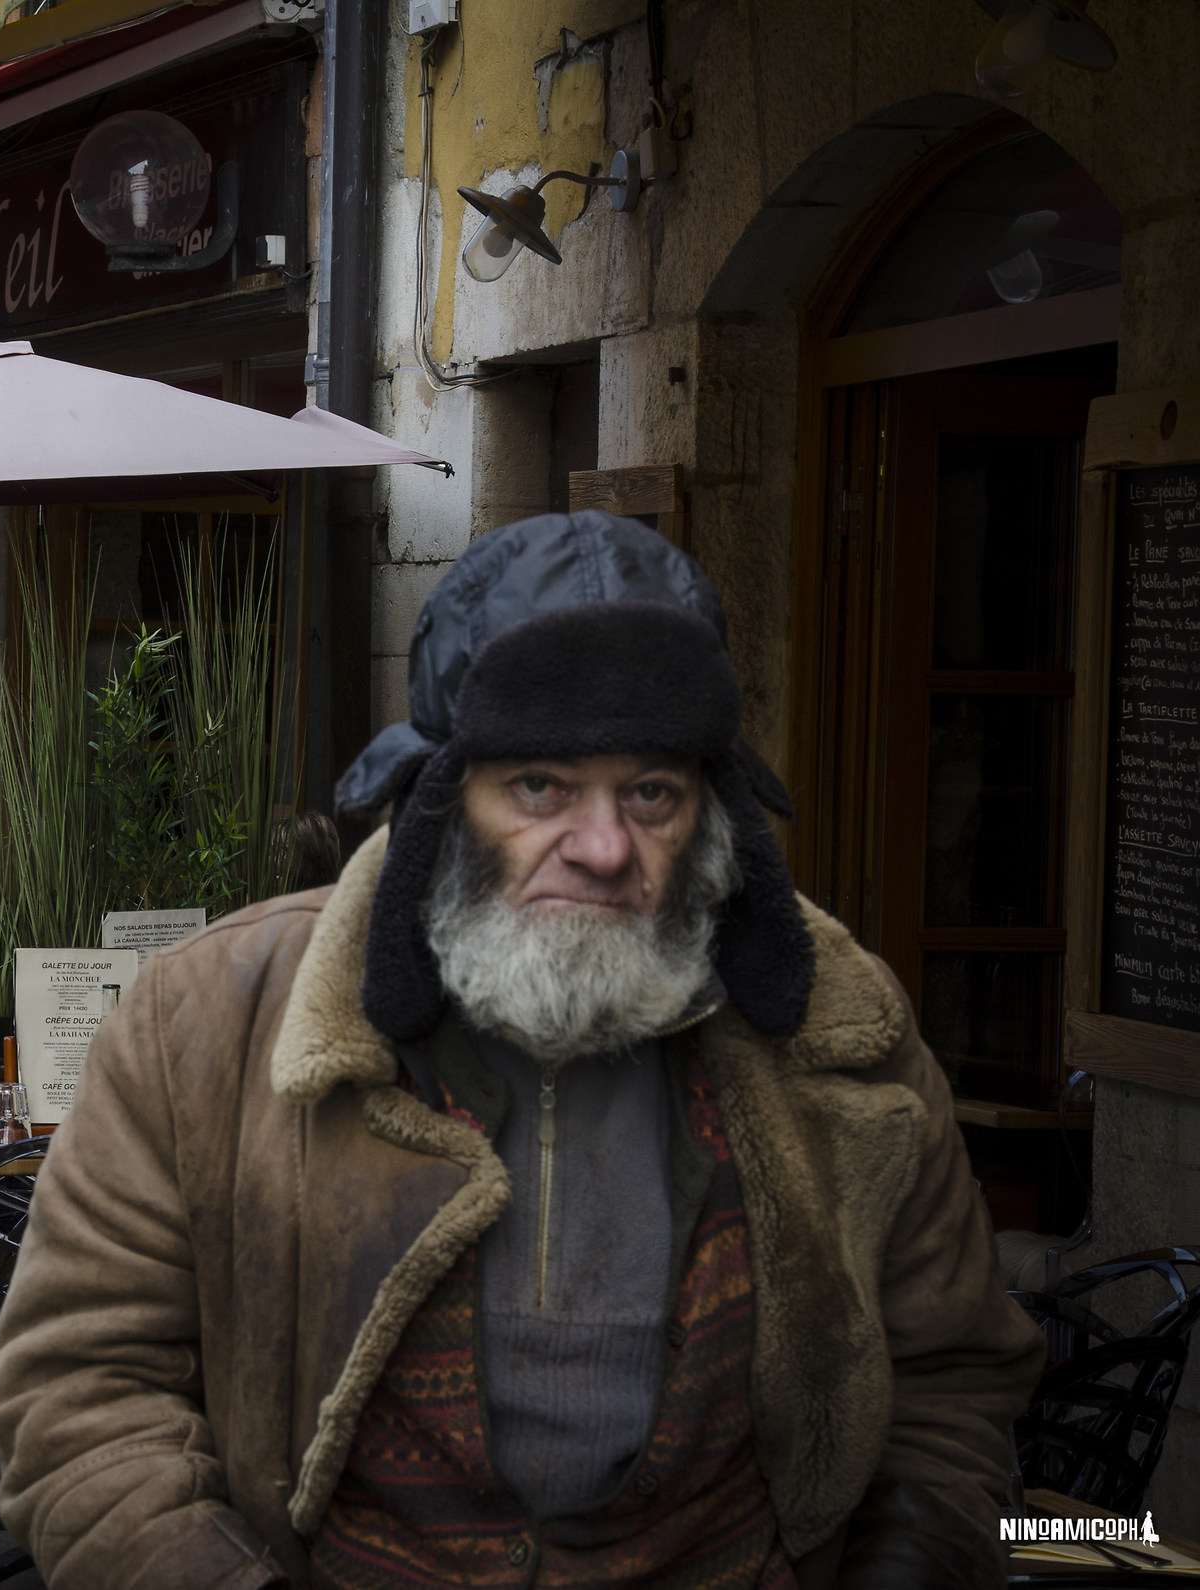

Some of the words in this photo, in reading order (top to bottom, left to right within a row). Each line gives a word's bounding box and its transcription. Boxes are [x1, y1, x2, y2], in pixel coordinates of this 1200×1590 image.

[108, 150, 213, 210] Brsserie
[1122, 699, 1133, 714] LA
[1138, 702, 1198, 719] TARTIFLETTE
[1119, 824, 1163, 845] L'ASSIETTE
[127, 923, 153, 931] SALADES
[42, 962, 76, 970] GALETTE
[90, 963, 112, 971] JOUR
[45, 1016, 71, 1025] CRÊPE
[42, 1082, 62, 1090] CAFÉ
